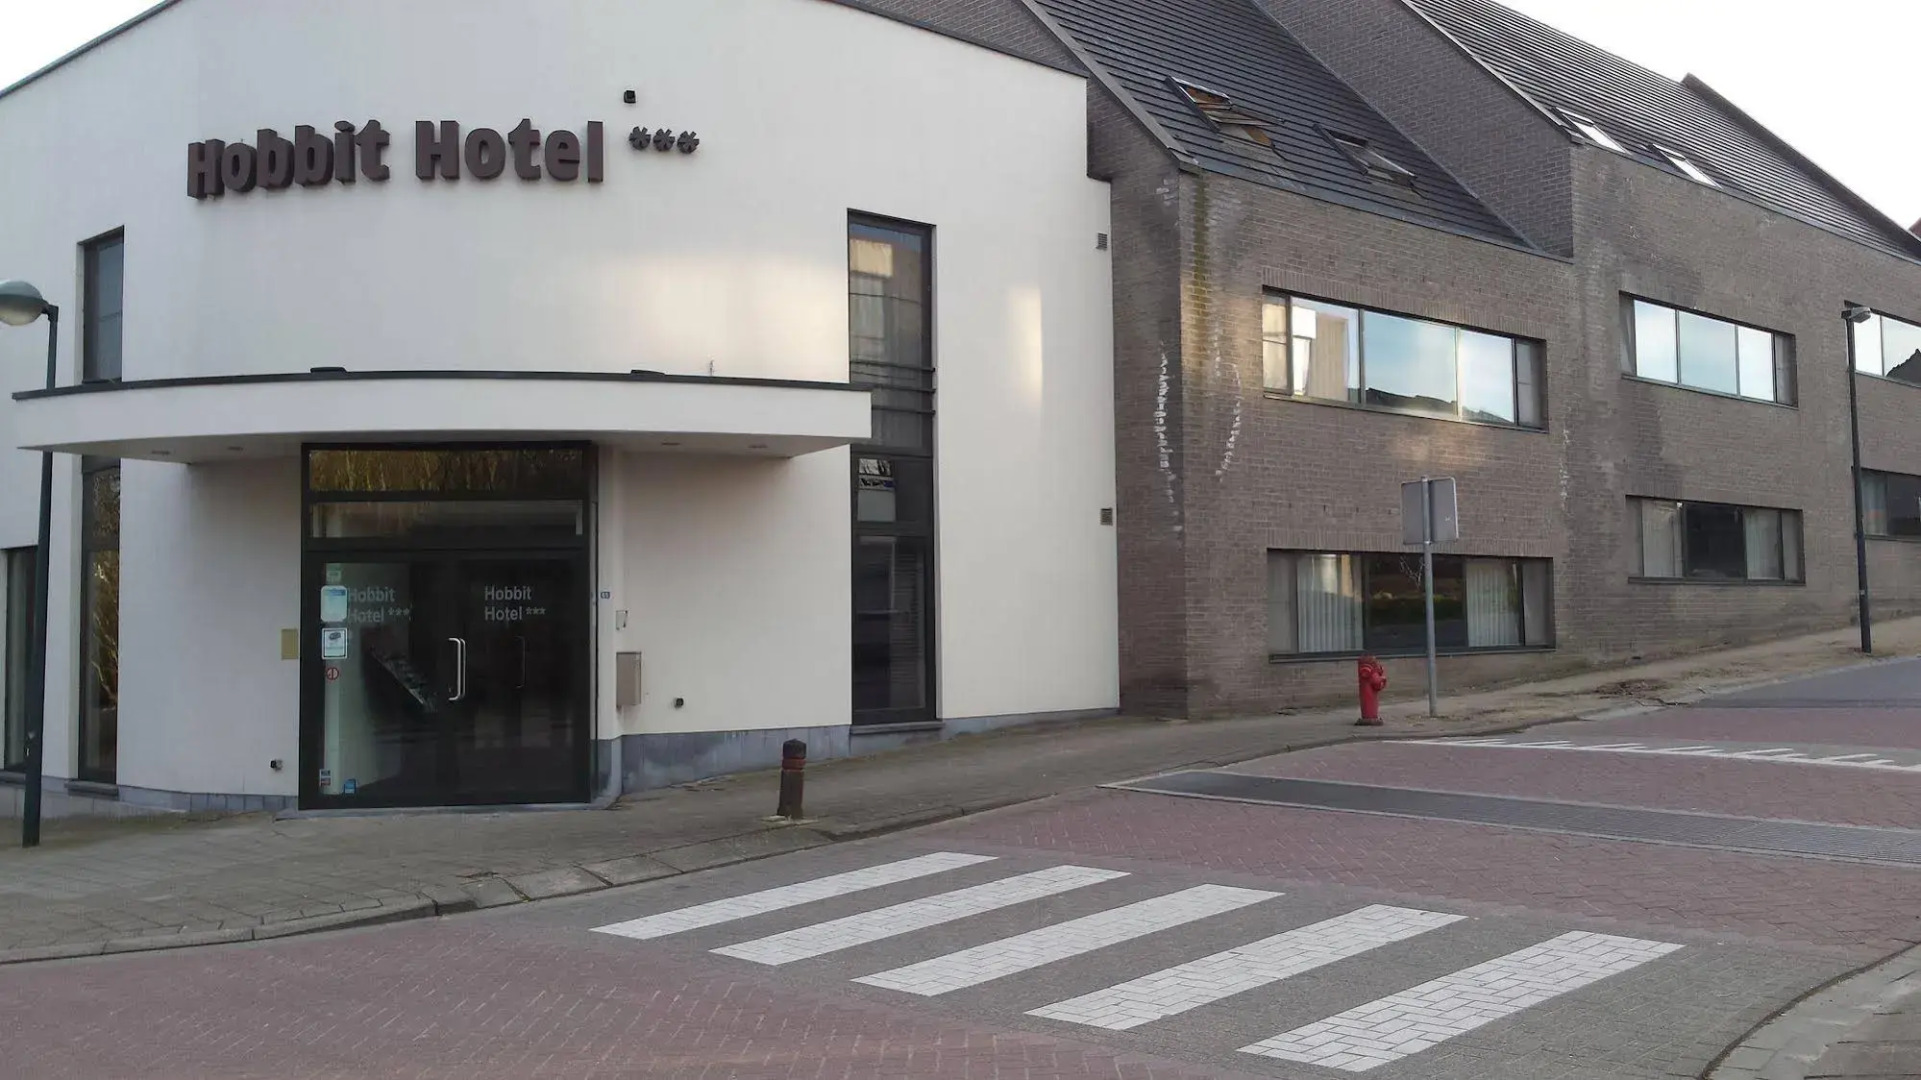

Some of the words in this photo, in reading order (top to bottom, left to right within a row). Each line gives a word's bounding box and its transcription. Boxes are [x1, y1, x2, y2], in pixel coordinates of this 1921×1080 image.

[187, 119, 390, 200] Hobbit
[415, 118, 604, 183] Hotel
[348, 586, 396, 602] Hobbit
[484, 585, 532, 601] Hobbit
[348, 606, 385, 623] Hotel
[484, 605, 523, 621] Hotel
